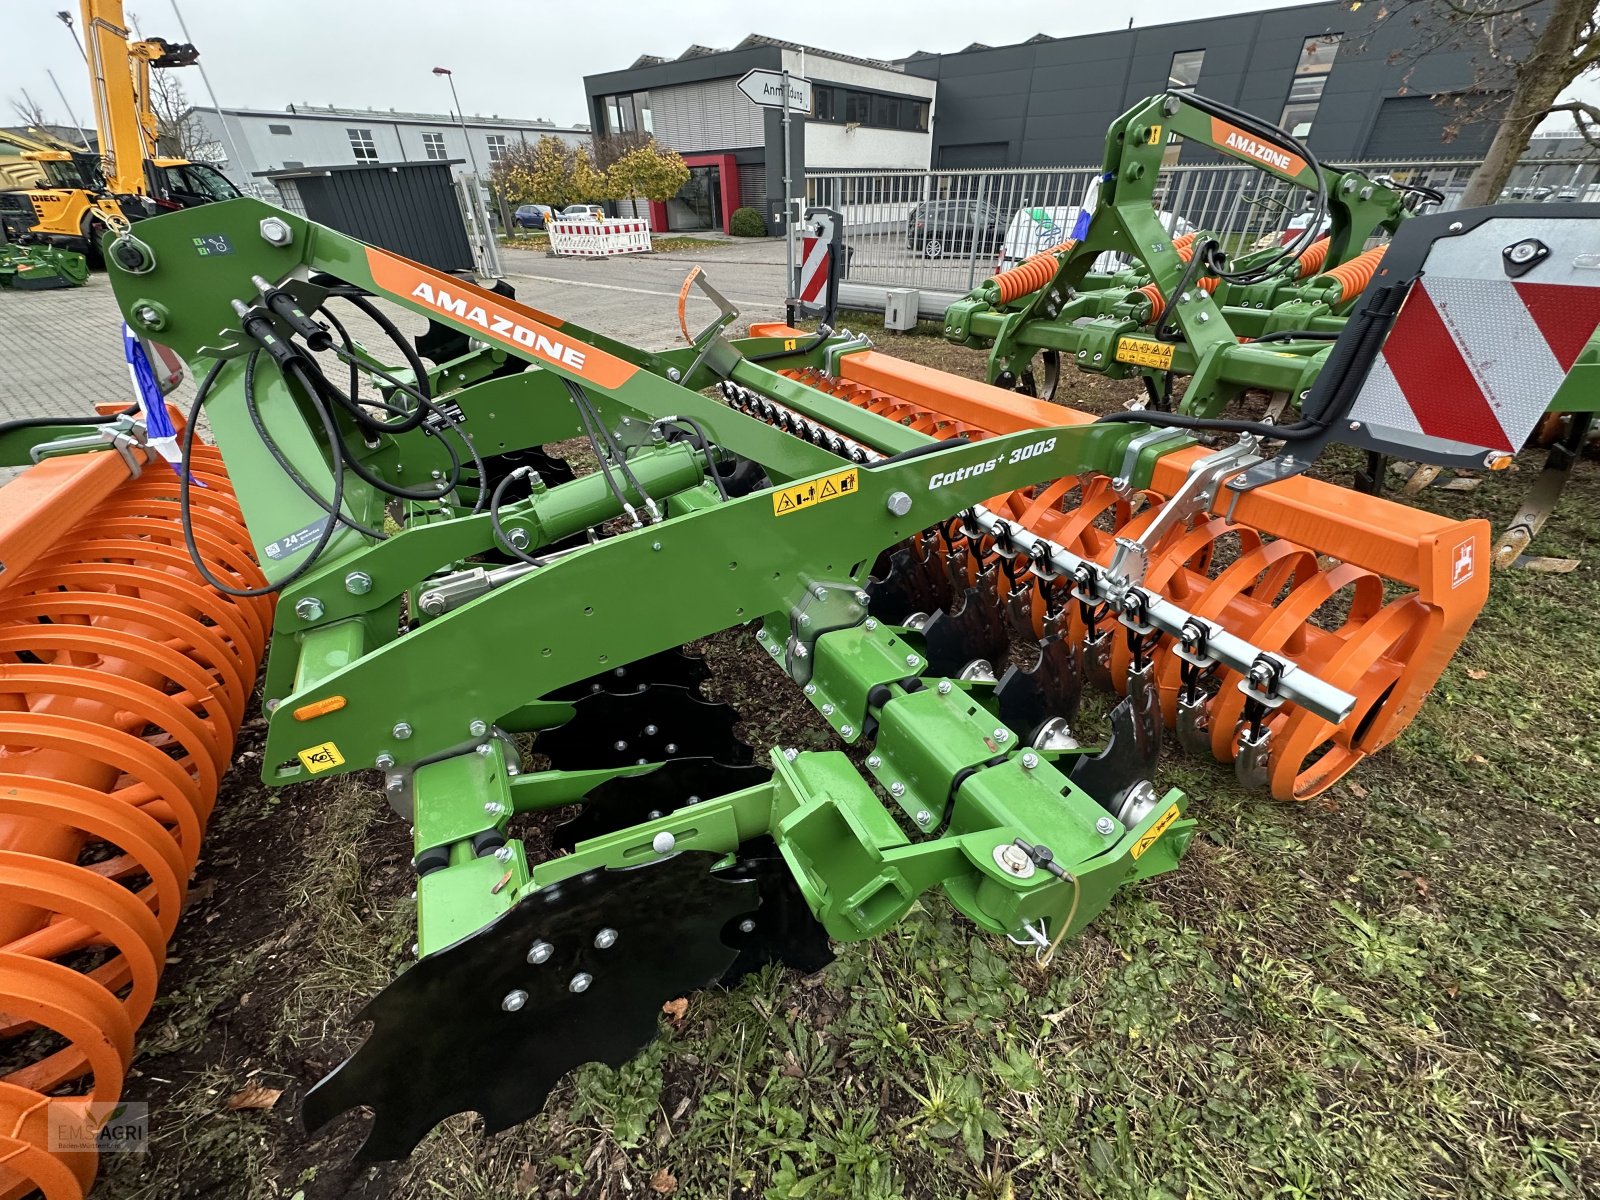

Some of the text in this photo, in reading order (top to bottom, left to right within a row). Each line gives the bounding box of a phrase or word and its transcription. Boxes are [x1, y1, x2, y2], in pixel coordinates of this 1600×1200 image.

[1225, 132, 1291, 170] AMAZONE
[412, 282, 586, 371] AMAZONE
[1008, 437, 1057, 465] 3003
[283, 534, 299, 548] 24
